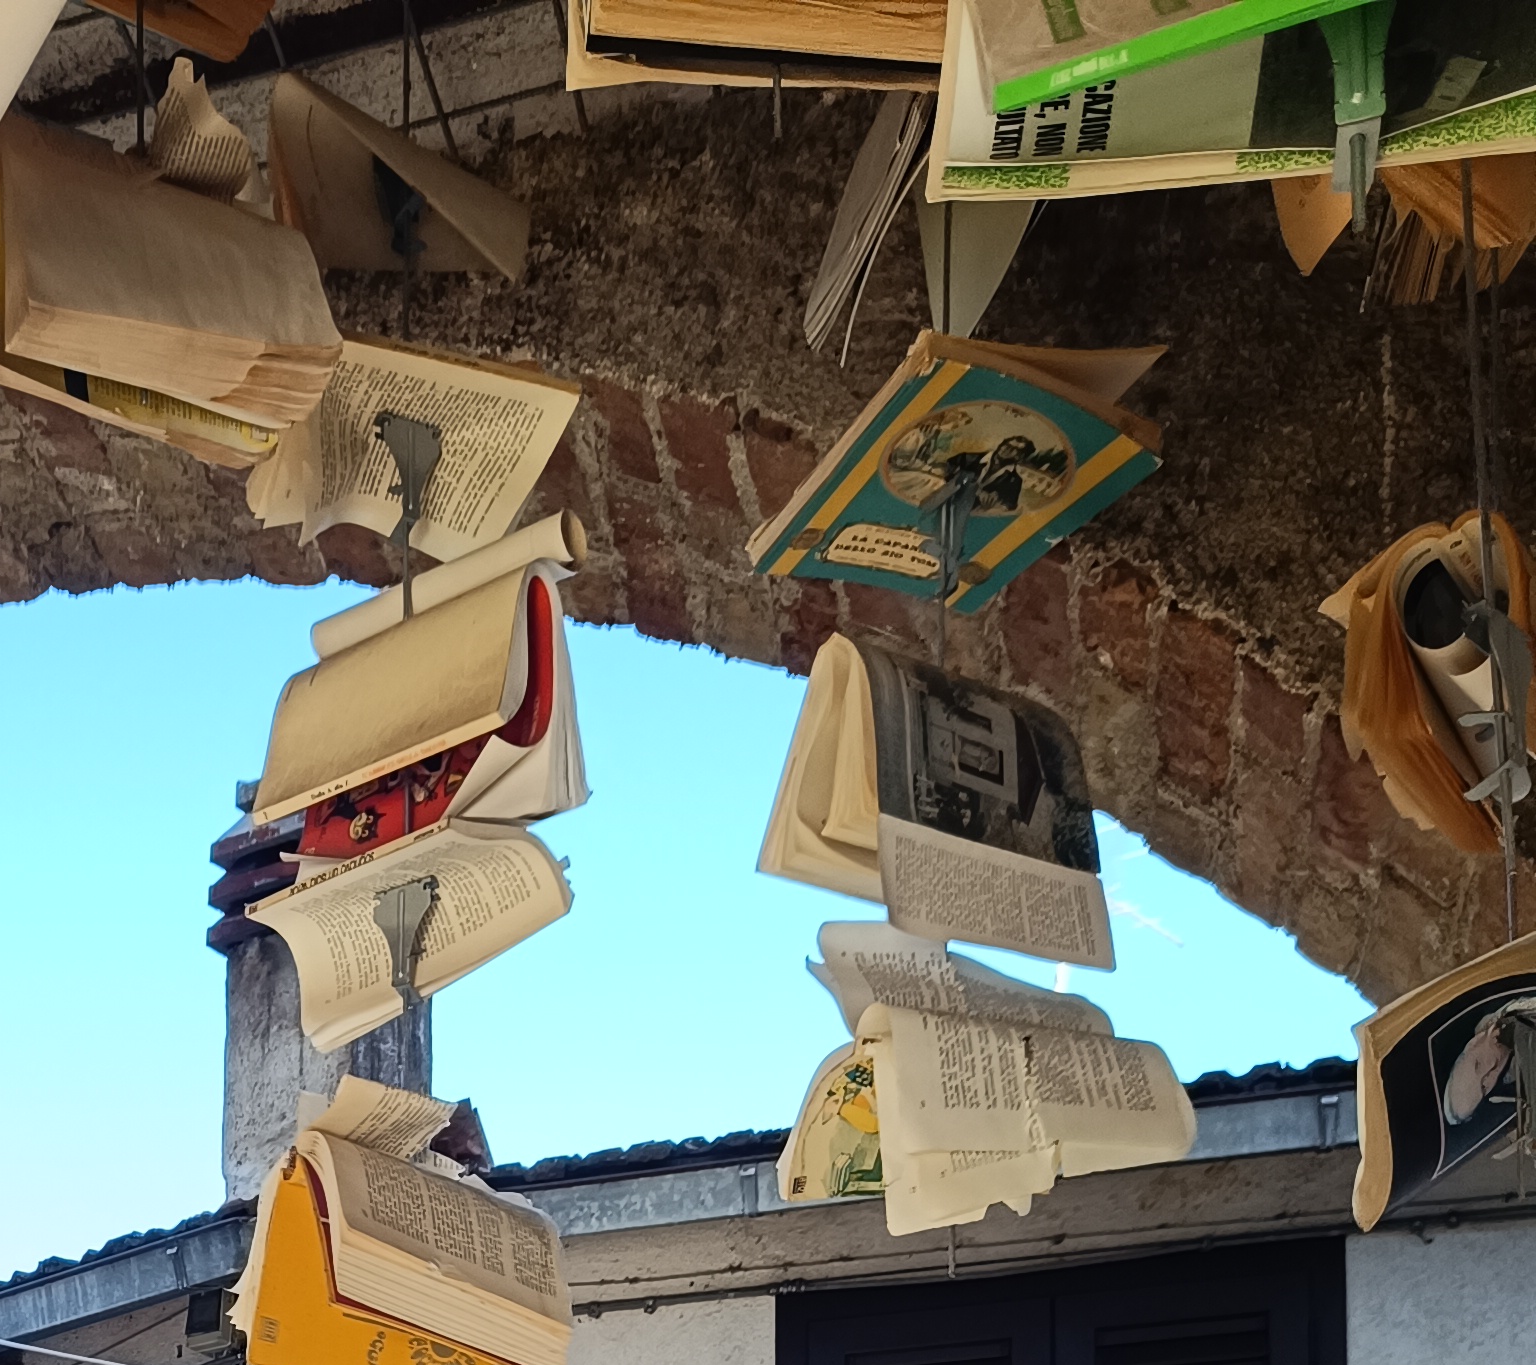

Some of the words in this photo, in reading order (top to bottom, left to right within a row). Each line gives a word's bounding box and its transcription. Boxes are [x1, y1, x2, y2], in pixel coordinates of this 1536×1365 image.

[990, 107, 1026, 160] ULTATO
[1076, 80, 1116, 153] CAZIONE
[1032, 123, 1067, 156] NON
[875, 538, 926, 554] CAPAN
